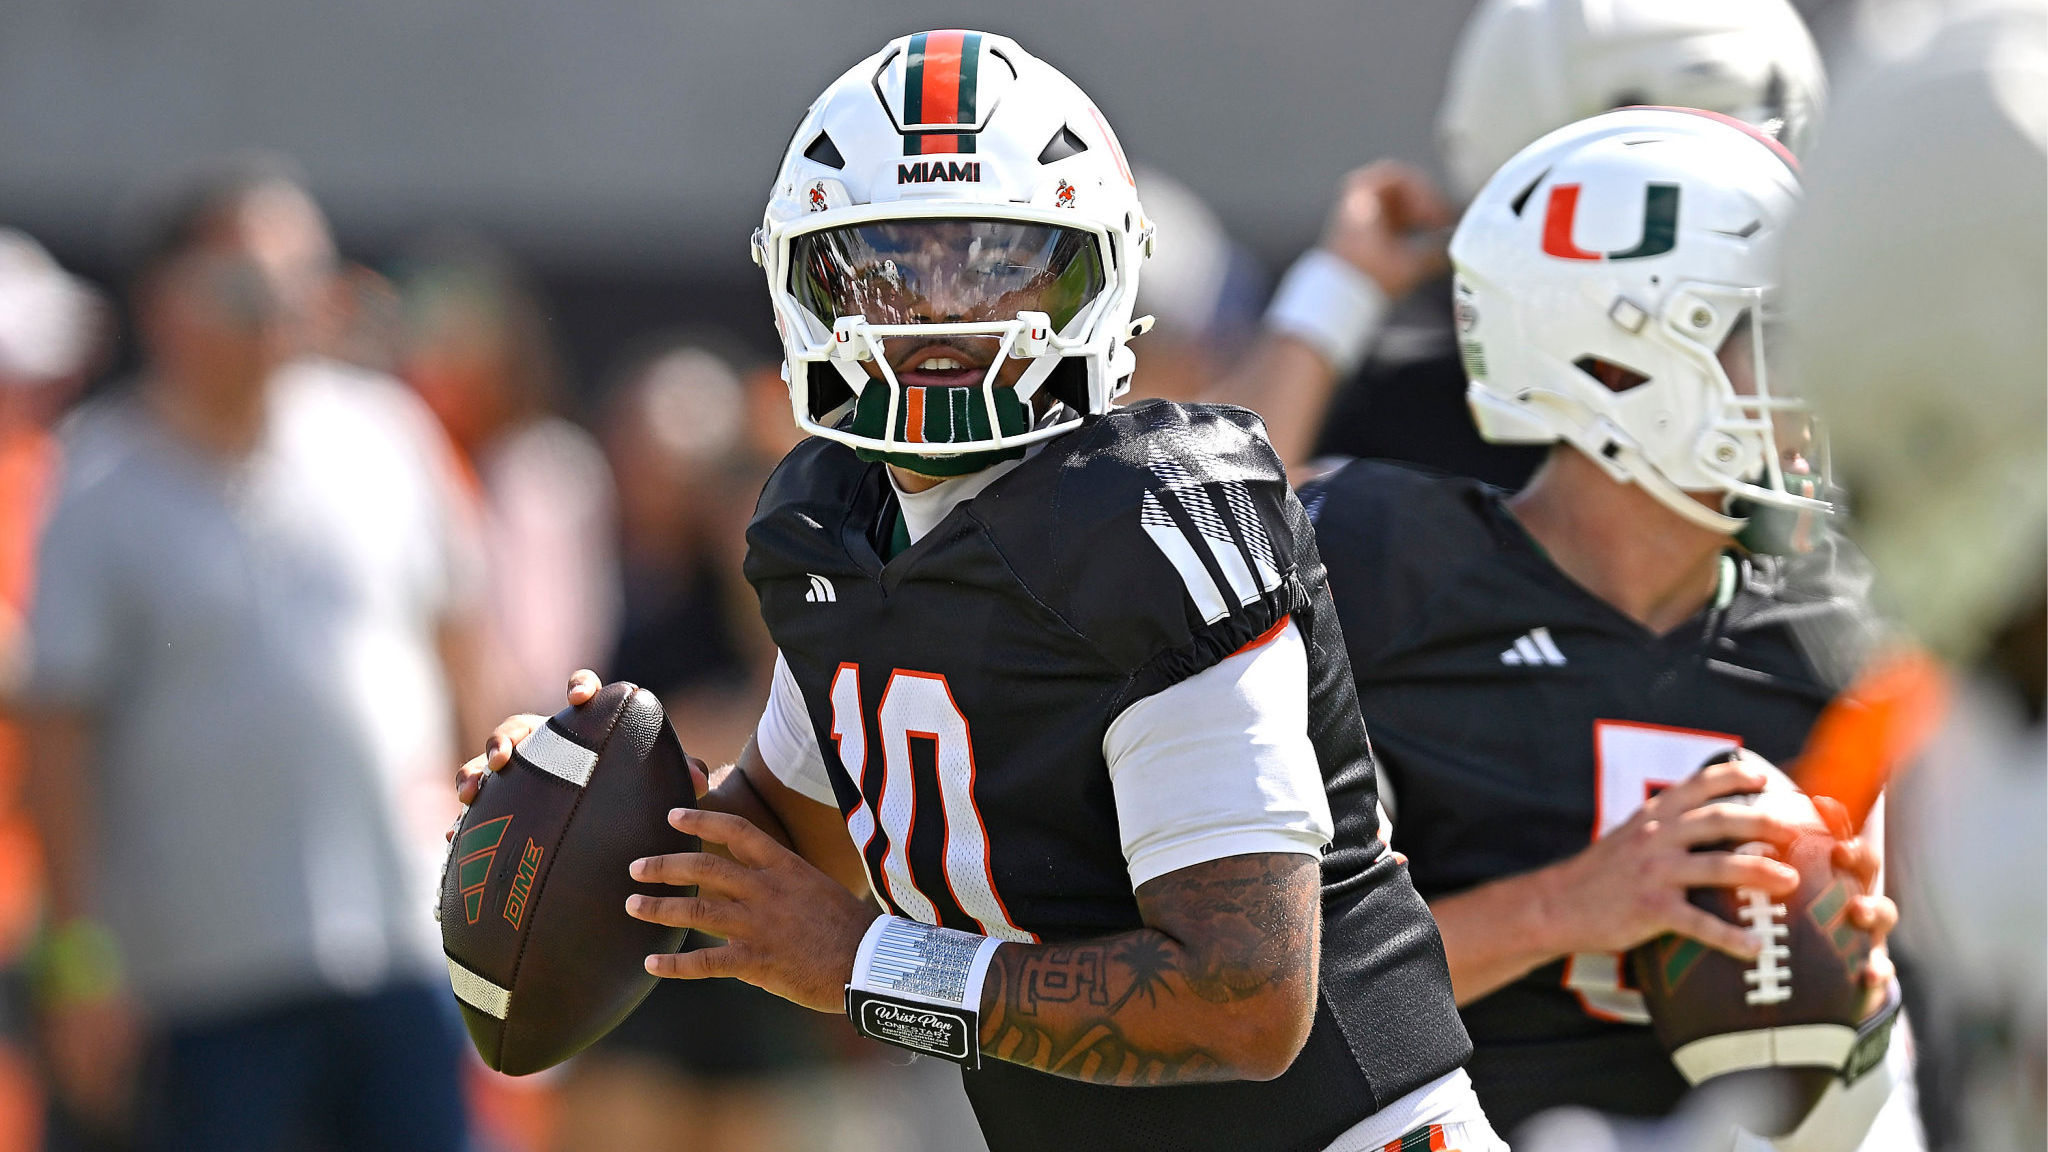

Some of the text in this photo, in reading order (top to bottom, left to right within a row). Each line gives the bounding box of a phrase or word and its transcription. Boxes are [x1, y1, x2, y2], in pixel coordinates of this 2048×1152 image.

[898, 161, 980, 184] MIAMI
[1541, 181, 1681, 262] U
[836, 331, 850, 343] U
[1031, 328, 1046, 340] U
[830, 661, 1042, 944] 10
[503, 836, 544, 932] DIME
[875, 1006, 953, 1031] Wrist Plan
